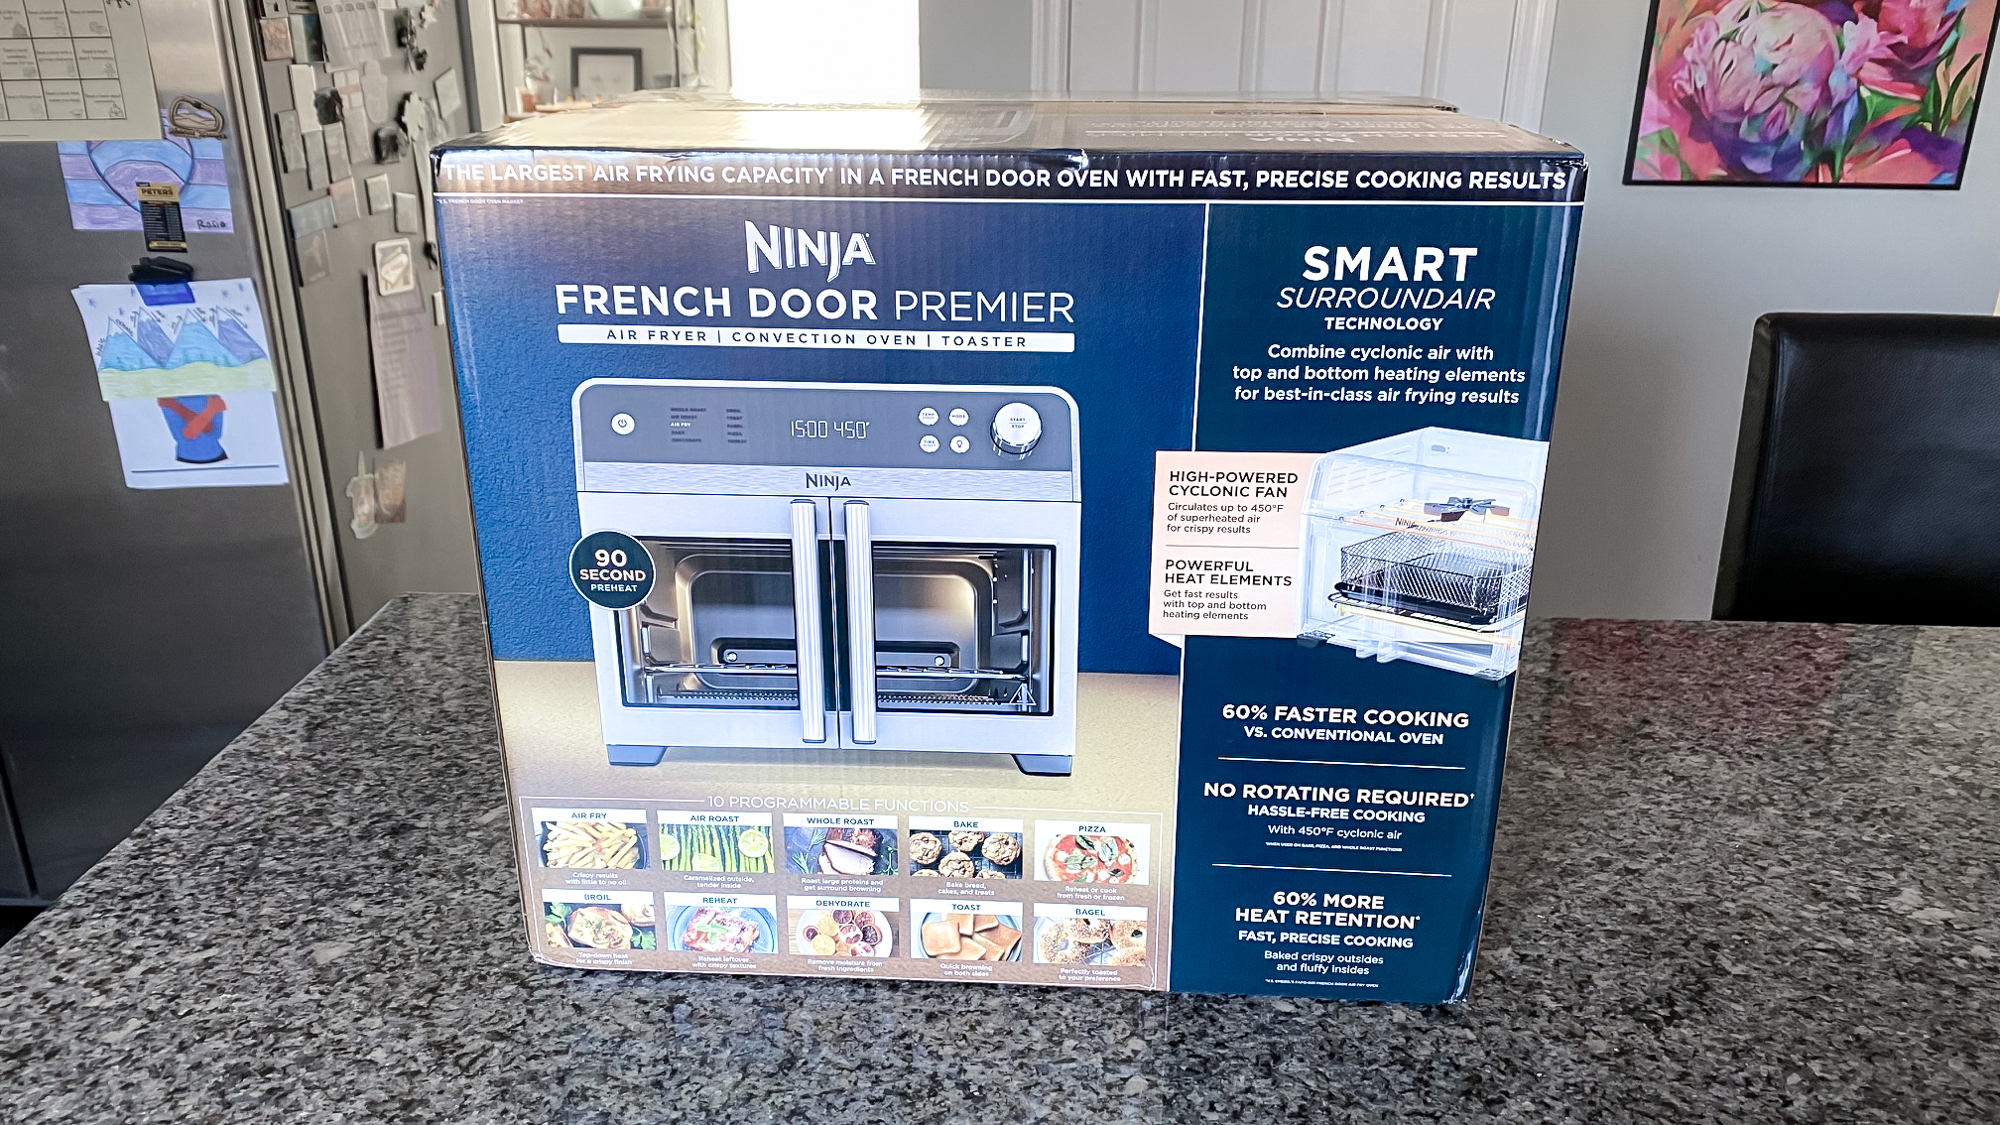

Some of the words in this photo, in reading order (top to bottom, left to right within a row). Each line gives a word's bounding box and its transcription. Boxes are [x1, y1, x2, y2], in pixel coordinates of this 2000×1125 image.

[444, 165, 485, 180] THE
[491, 165, 586, 181] LARGEST
[593, 165, 629, 181] AIR
[637, 166, 715, 182] FRYING
[840, 168, 861, 184] IN
[869, 168, 884, 184] A
[892, 168, 979, 186] FRENCH
[986, 170, 1050, 187] DOOR
[1057, 170, 1118, 187] OVEN
[1126, 170, 1184, 187] WITH
[1191, 170, 1249, 191] FAST,
[1256, 170, 1349, 189] PRECISE
[1355, 170, 1462, 190] COOKING
[1468, 172, 1566, 190] RESULTS
[745, 219, 876, 283] NINJA
[1302, 246, 1478, 282] SMART
[555, 284, 730, 318] FRENCH
[749, 287, 878, 321] DOOR
[895, 291, 1074, 323] PREMIER
[1277, 287, 1496, 310] SURROUNDAIR
[1324, 317, 1443, 331] TECHNOLOGY
[607, 329, 642, 341] AIR
[648, 329, 707, 342] FRYER
[732, 331, 860, 345] CONVECTION
[866, 334, 916, 346] OVEN
[942, 335, 1026, 347] TOASTER
[1268, 344, 1346, 359] Combine
[1350, 344, 1423, 362] cyclonic
[1427, 346, 1450, 360] air
[1455, 346, 1494, 360] with
[1233, 367, 1262, 381] top
[1267, 365, 1299, 380] and
[1304, 366, 1368, 381] bottom
[1374, 367, 1440, 383] heating
[1445, 368, 1526, 383] elements
[1234, 386, 1259, 400] for
[1264, 387, 1372, 401] best-in-class
[1377, 388, 1400, 402] air
[1405, 388, 1456, 405] frying
[1461, 389, 1519, 404] results
[1169, 471, 1298, 483] HIGH-POWERED
[1169, 485, 1250, 497] CYCLONIC
[1255, 487, 1287, 497] FAN
[1168, 502, 1218, 512] Circulates
[1221, 504, 1234, 513] up
[1237, 504, 1248, 512] to
[1251, 504, 1284, 512] 450°F
[1167, 513, 1177, 522] of
[1180, 514, 1244, 524] superheated
[1247, 515, 1260, 523] air
[1167, 524, 1181, 532] for
[1184, 525, 1214, 534] crispy
[1217, 525, 1251, 534] results
[594, 549, 627, 567] 90
[1166, 559, 1254, 572] POWERFUL
[579, 569, 646, 582] SECOND
[1165, 573, 1205, 584] HEAT
[1210, 574, 1292, 586] ELEMENTS
[590, 584, 637, 592] PREHEAT
[1164, 589, 1181, 598] Get
[1184, 590, 1202, 598] fast
[1205, 591, 1238, 599] results
[1163, 600, 1184, 608] with
[1187, 601, 1205, 610] top
[1207, 601, 1226, 609] and
[1229, 602, 1267, 610] bottom
[1163, 610, 1200, 620] heating
[1203, 611, 1249, 620] elements
[1222, 704, 1268, 721] 60%
[1275, 706, 1357, 724] FASTER
[1364, 709, 1470, 728] COOKING
[1244, 726, 1268, 738] VS.
[1271, 727, 1395, 743] CONVENTIONAL
[1399, 732, 1444, 745] OVEN
[1204, 782, 1236, 798] NO
[1243, 785, 1350, 802] ROTATING
[707, 796, 724, 807] 10
[729, 796, 869, 811] PROGRAMMABLE
[874, 799, 969, 813] FUNCTIONS
[1248, 805, 1349, 820] HASSLE-FREE
[1353, 809, 1425, 823] COOKING
[843, 818, 874, 826] ROAST
[1079, 825, 1106, 833] PIZZA
[1268, 825, 1296, 835] With
[1299, 826, 1334, 836] 450°F
[1337, 828, 1384, 840] cyclonic
[1387, 830, 1402, 840] air
[572, 872, 593, 880] Crispy
[840, 879, 869, 887] proteins
[849, 885, 881, 893] browning
[816, 900, 870, 908] DEHYDRATE
[1273, 891, 1317, 906] 60%
[1324, 894, 1385, 910] MORE
[1075, 908, 1106, 916] BAGEL
[1235, 908, 1290, 923] HEAT
[1238, 930, 1277, 944] FAST,
[1280, 932, 1340, 946] PRECISE
[1344, 935, 1414, 948] COOKING
[1264, 950, 1298, 961] Baked
[1301, 952, 1334, 964] crispy
[1337, 954, 1384, 965] outsides
[1277, 962, 1297, 972] and
[1300, 964, 1328, 975] fluffy
[1332, 965, 1370, 975] insides
